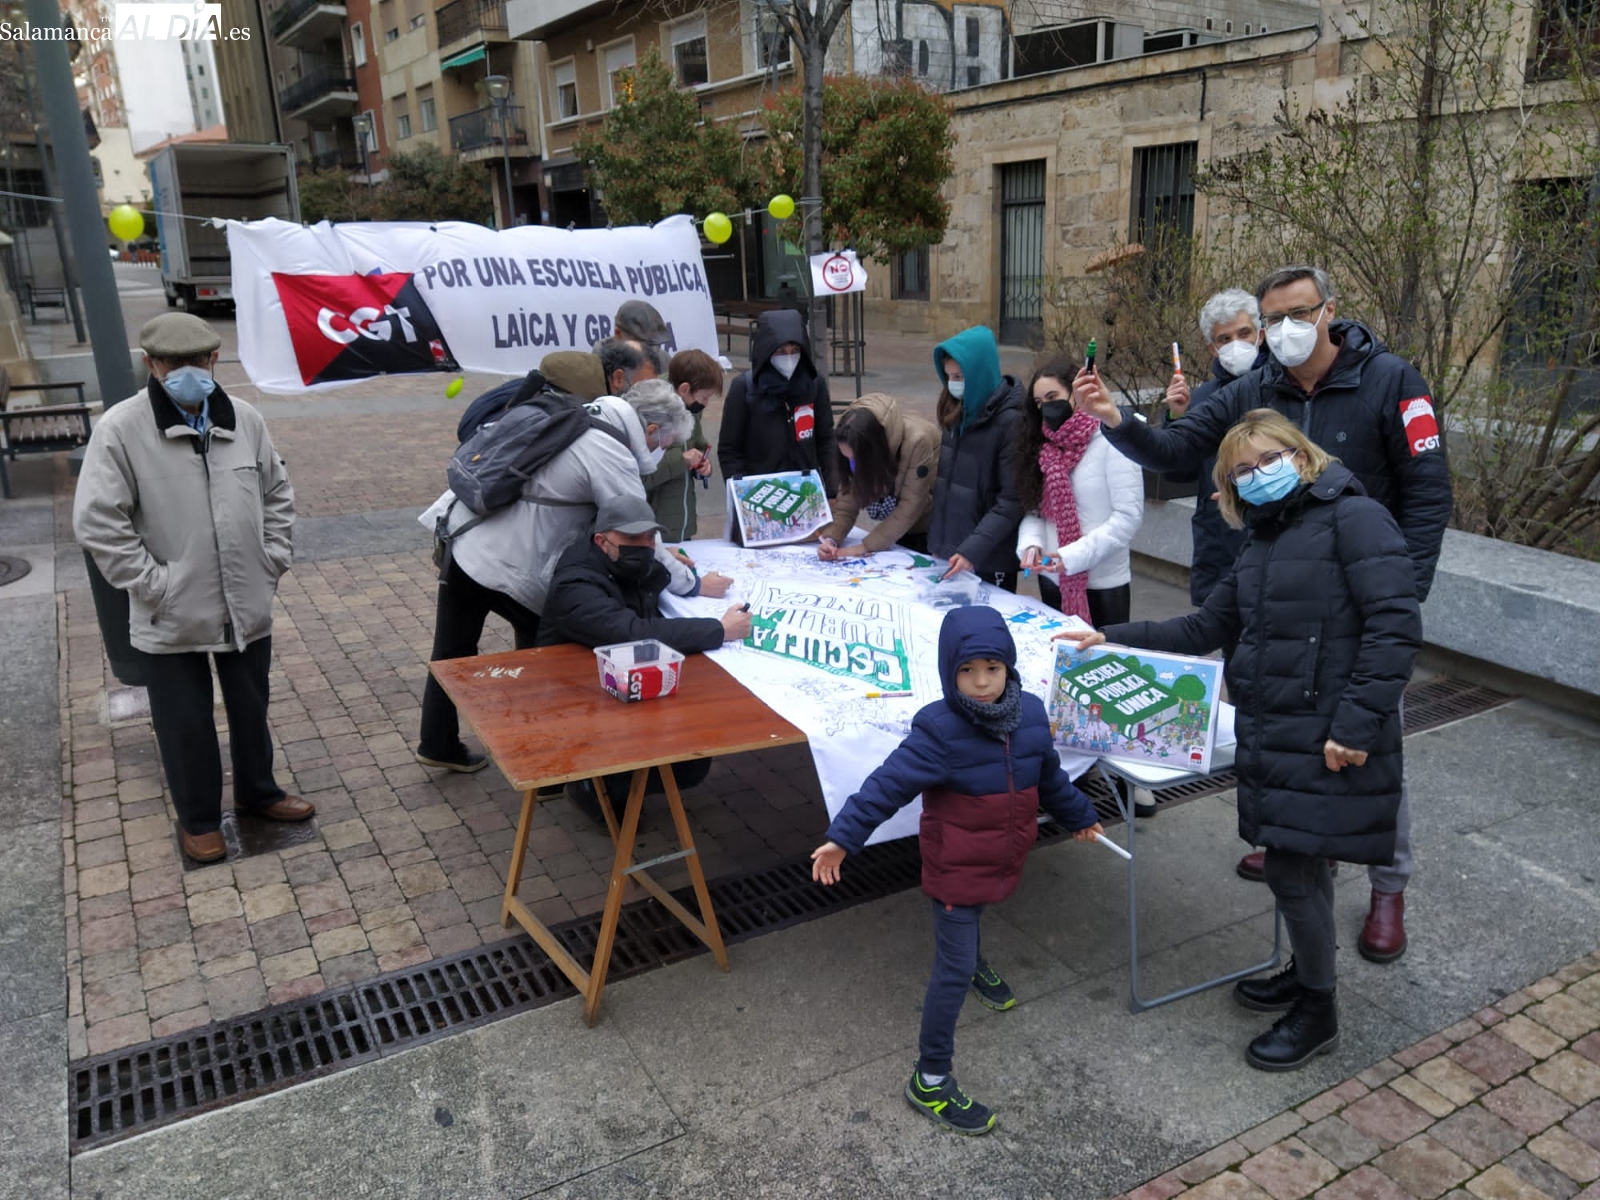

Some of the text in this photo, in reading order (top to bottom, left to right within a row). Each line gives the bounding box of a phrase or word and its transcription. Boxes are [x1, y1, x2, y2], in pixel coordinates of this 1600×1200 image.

[422, 258, 472, 290] POR
[473, 257, 527, 287] UNA
[526, 258, 626, 292] ESCUELA
[829, 263, 848, 274] NO
[317, 304, 417, 344] CGT
[562, 313, 577, 347] Y
[798, 428, 813, 439] CGT
[1413, 434, 1440, 452] CGT
[753, 625, 904, 686] ESCUELA
[630, 671, 643, 700] CGT
[1075, 660, 1129, 688] ESCUELA
[1094, 674, 1149, 702] PÚBLICA
[1114, 687, 1169, 716] ÚNICA
